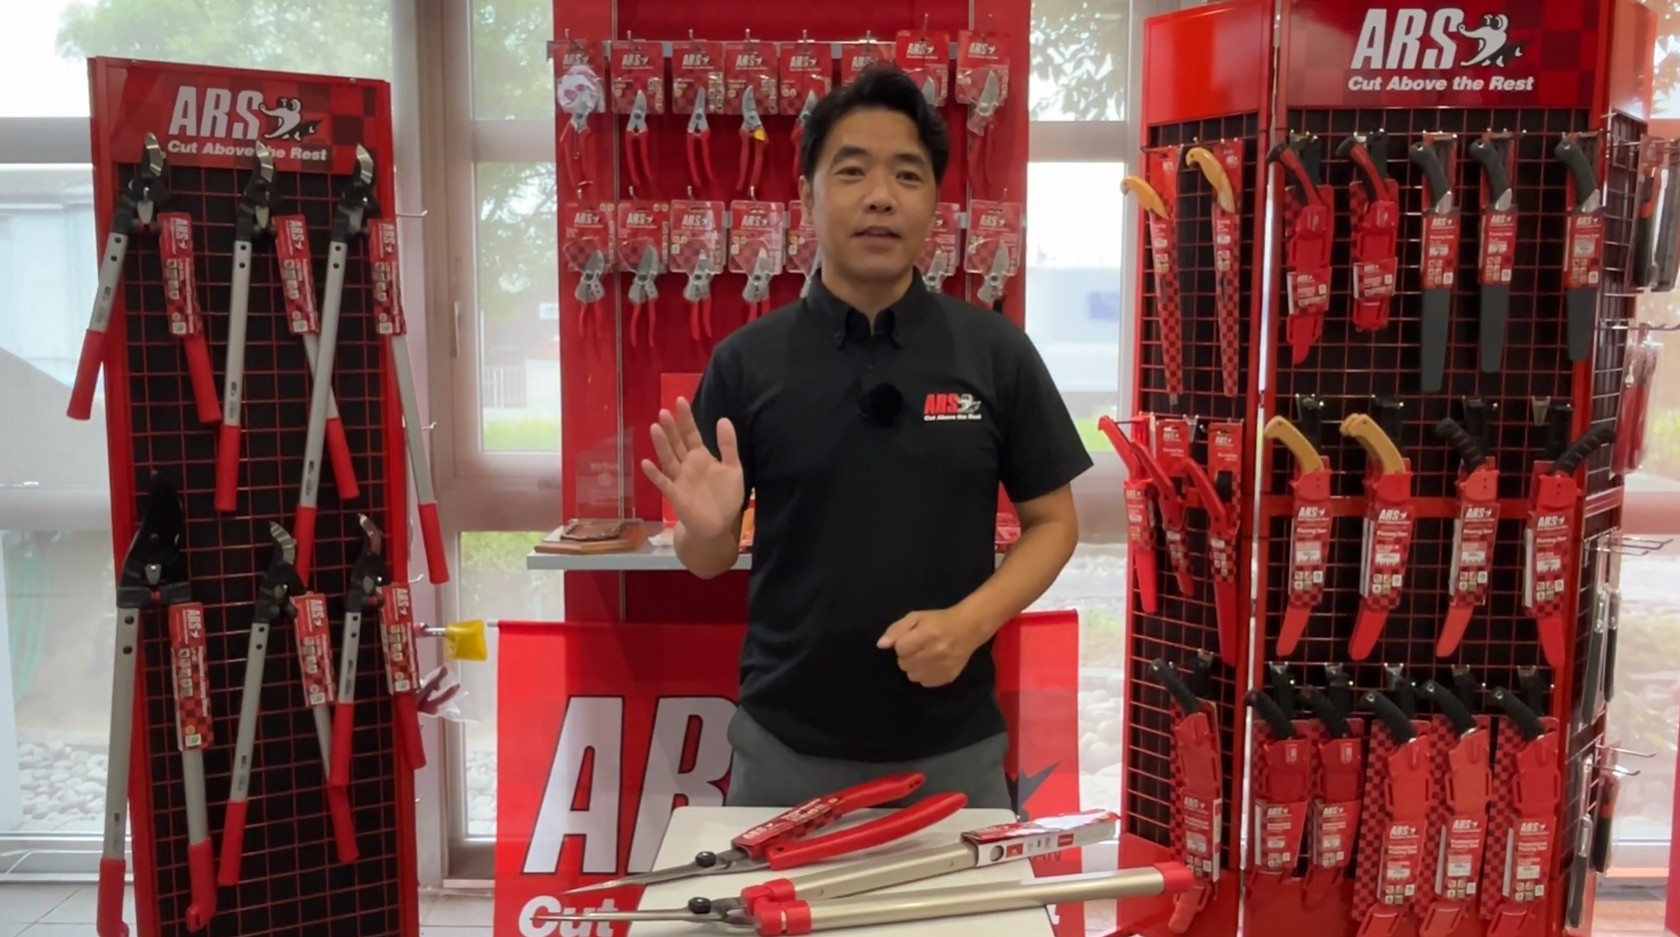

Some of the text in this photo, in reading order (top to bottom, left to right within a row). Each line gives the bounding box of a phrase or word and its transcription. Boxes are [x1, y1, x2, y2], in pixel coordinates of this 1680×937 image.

[1351, 8, 1464, 70] ARS
[907, 43, 927, 55] ARS
[969, 42, 988, 54] ARS
[682, 54, 702, 66] ARS
[736, 55, 755, 66] ARS
[790, 56, 809, 68] ARS
[1348, 76, 1535, 91] Cut Above the Rest
[168, 86, 264, 140] ARS
[167, 140, 197, 154] Cut
[202, 142, 254, 157] Above
[290, 147, 327, 161] Rest
[574, 212, 594, 224] ARS
[626, 213, 646, 224] ARS
[682, 215, 702, 226] ARS
[742, 215, 761, 226] ARS
[980, 215, 998, 227] ARS
[175, 217, 189, 240] ARS
[289, 220, 305, 242] ARS
[383, 223, 395, 244] ARS
[924, 394, 959, 414] ARS
[1298, 506, 1319, 517] ARS
[1379, 509, 1399, 520] ARS
[1465, 507, 1486, 518] ARS
[1537, 516, 1557, 527] ARS
[396, 588, 410, 607] ARS
[310, 599, 325, 619] ARS
[187, 609, 202, 630] ARS
[520, 695, 738, 876] AR
[1452, 819, 1472, 829] ARS
[1520, 822, 1539, 833] ARS
[1390, 825, 1409, 836] ARS
[518, 895, 618, 937] Cut
